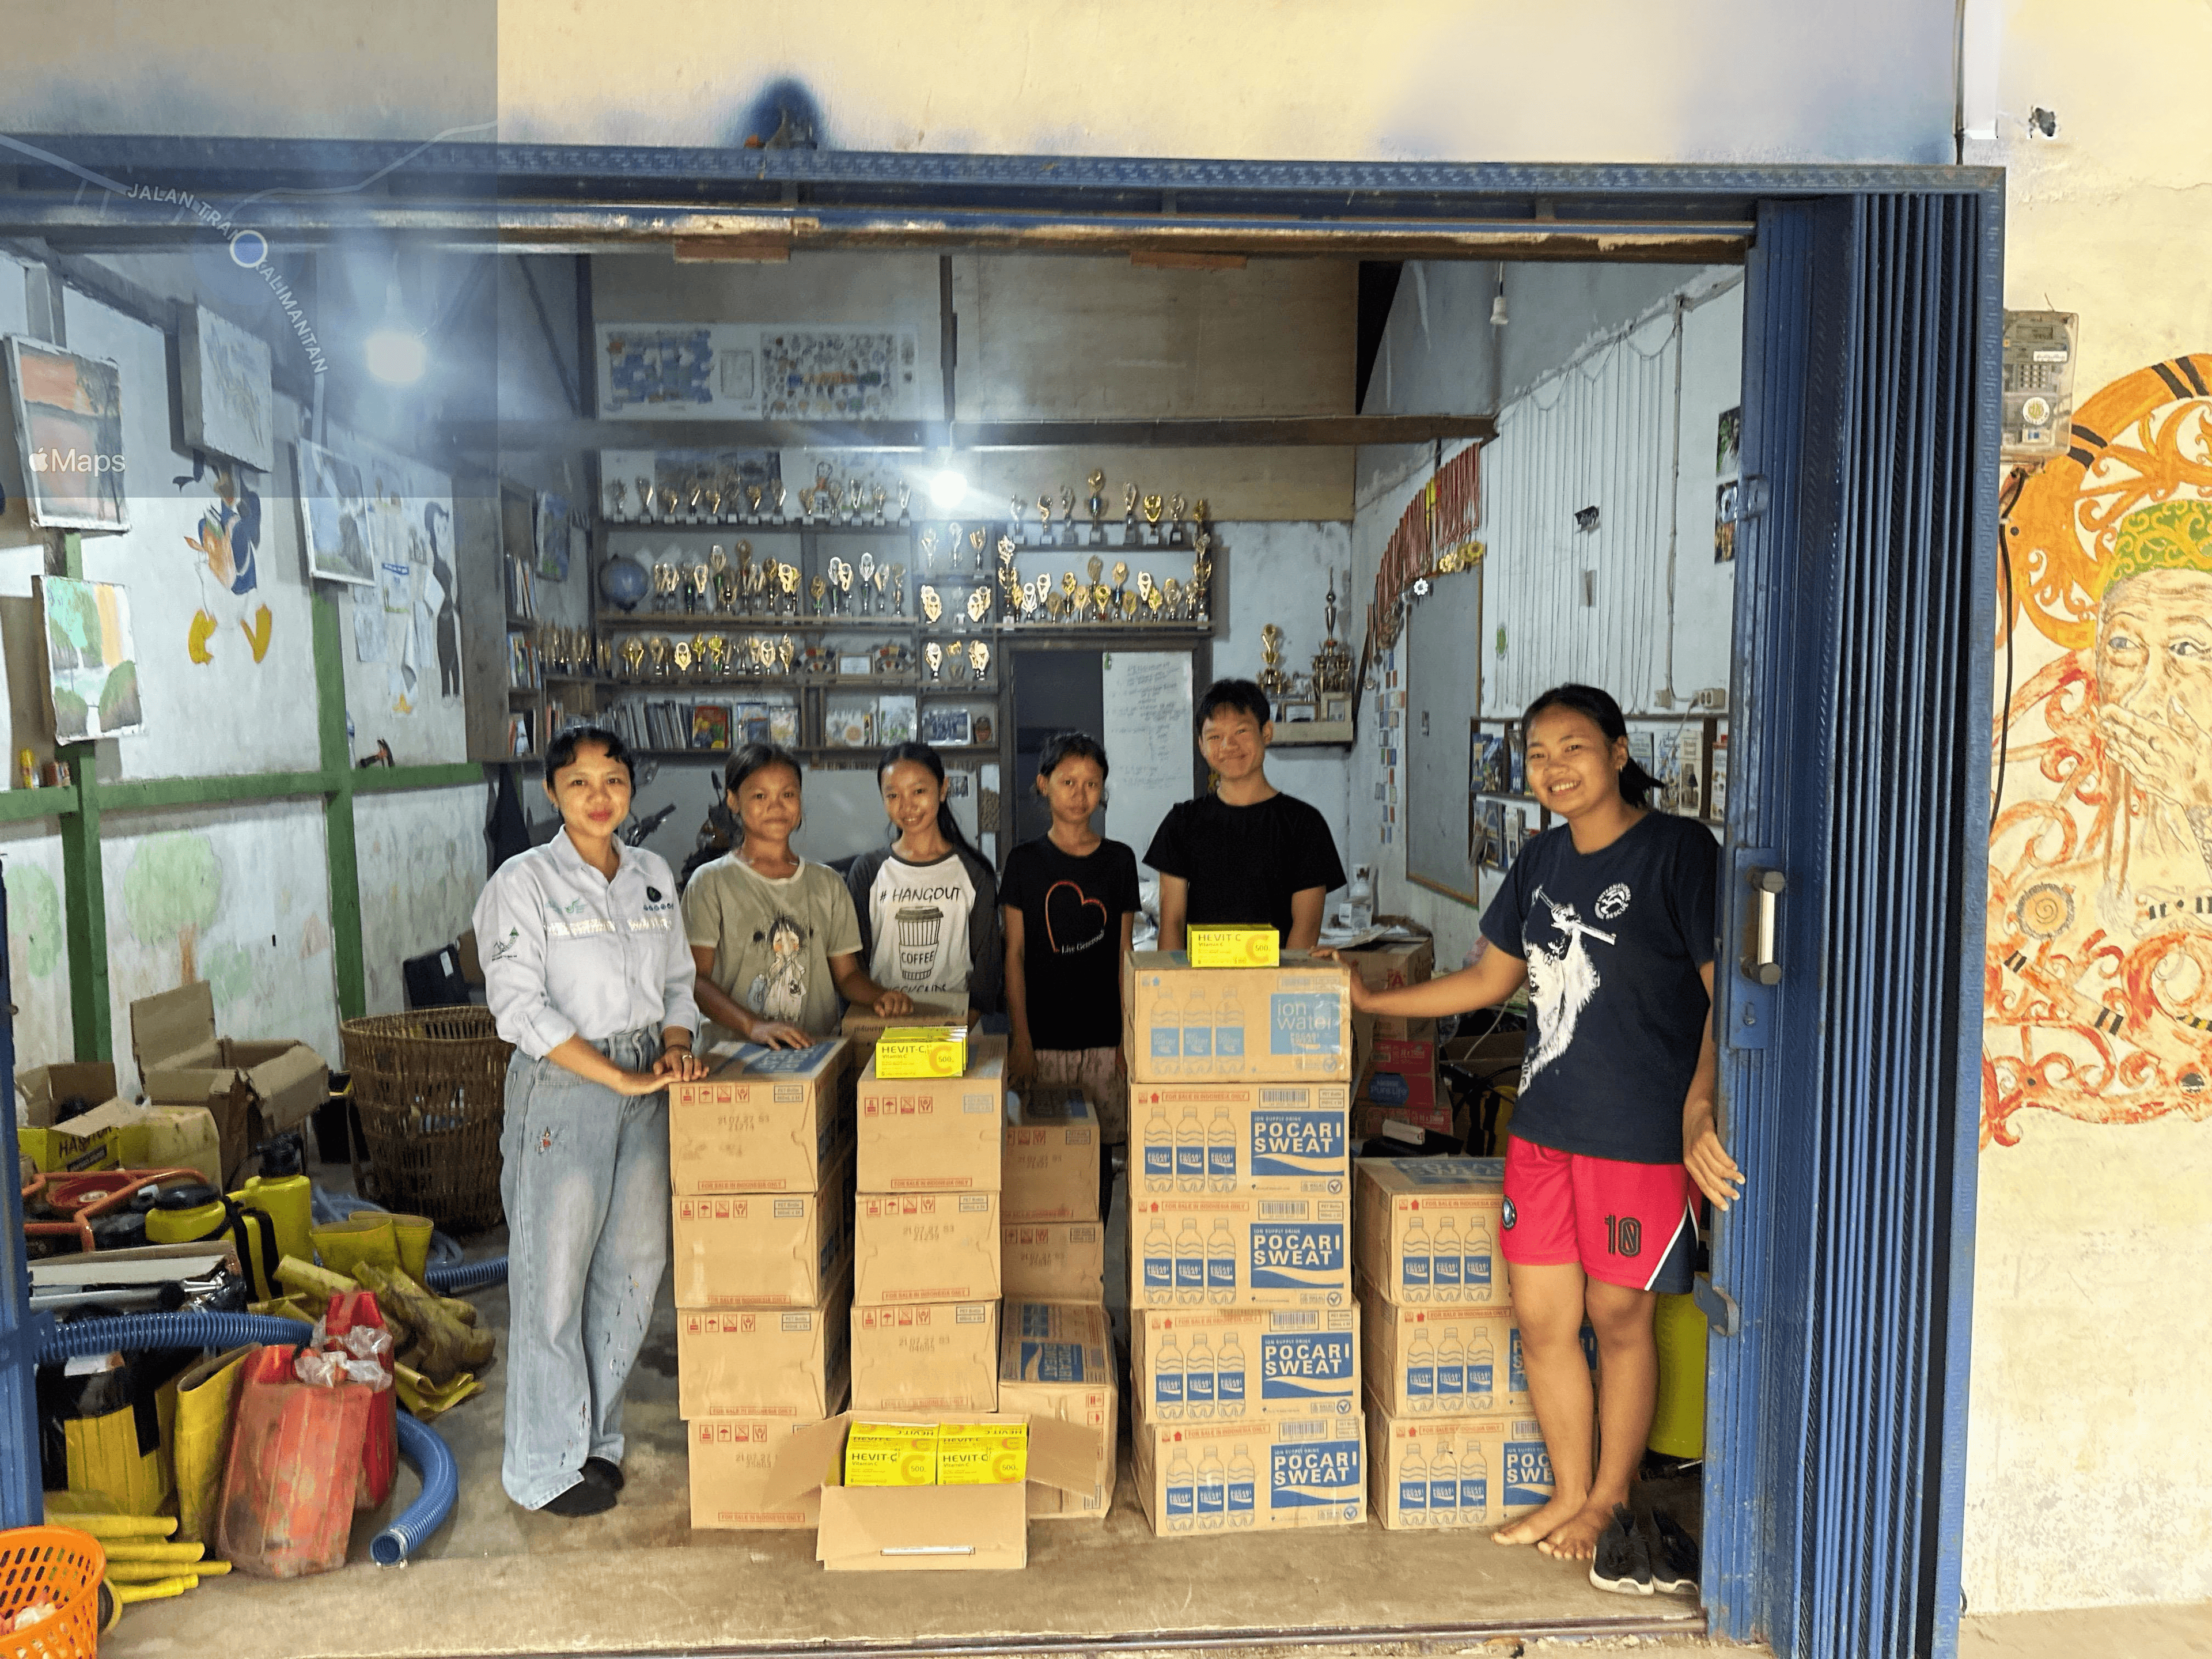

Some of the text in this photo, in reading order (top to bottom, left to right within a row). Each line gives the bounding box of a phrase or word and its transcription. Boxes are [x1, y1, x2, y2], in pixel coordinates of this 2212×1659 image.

[880, 887, 961, 903] # HANGOUT
[902, 950, 934, 965] COFFEE
[1277, 999, 1307, 1017] ion
[1277, 1016, 1332, 1031] water
[1254, 1122, 1341, 1138] POCARI
[1254, 1138, 1333, 1153] SWEAT
[1253, 1235, 1340, 1250] POCARI
[1604, 1214, 1641, 1257] 10
[1253, 1249, 1332, 1265] SWEAT
[1265, 1343, 1350, 1361] POCARI
[1265, 1359, 1342, 1376] SWEAT
[1274, 1451, 1357, 1471] POCARI
[1506, 1453, 1550, 1469] POC
[1274, 1467, 1349, 1486] SWEAT
[1506, 1467, 1554, 1483] SWE
